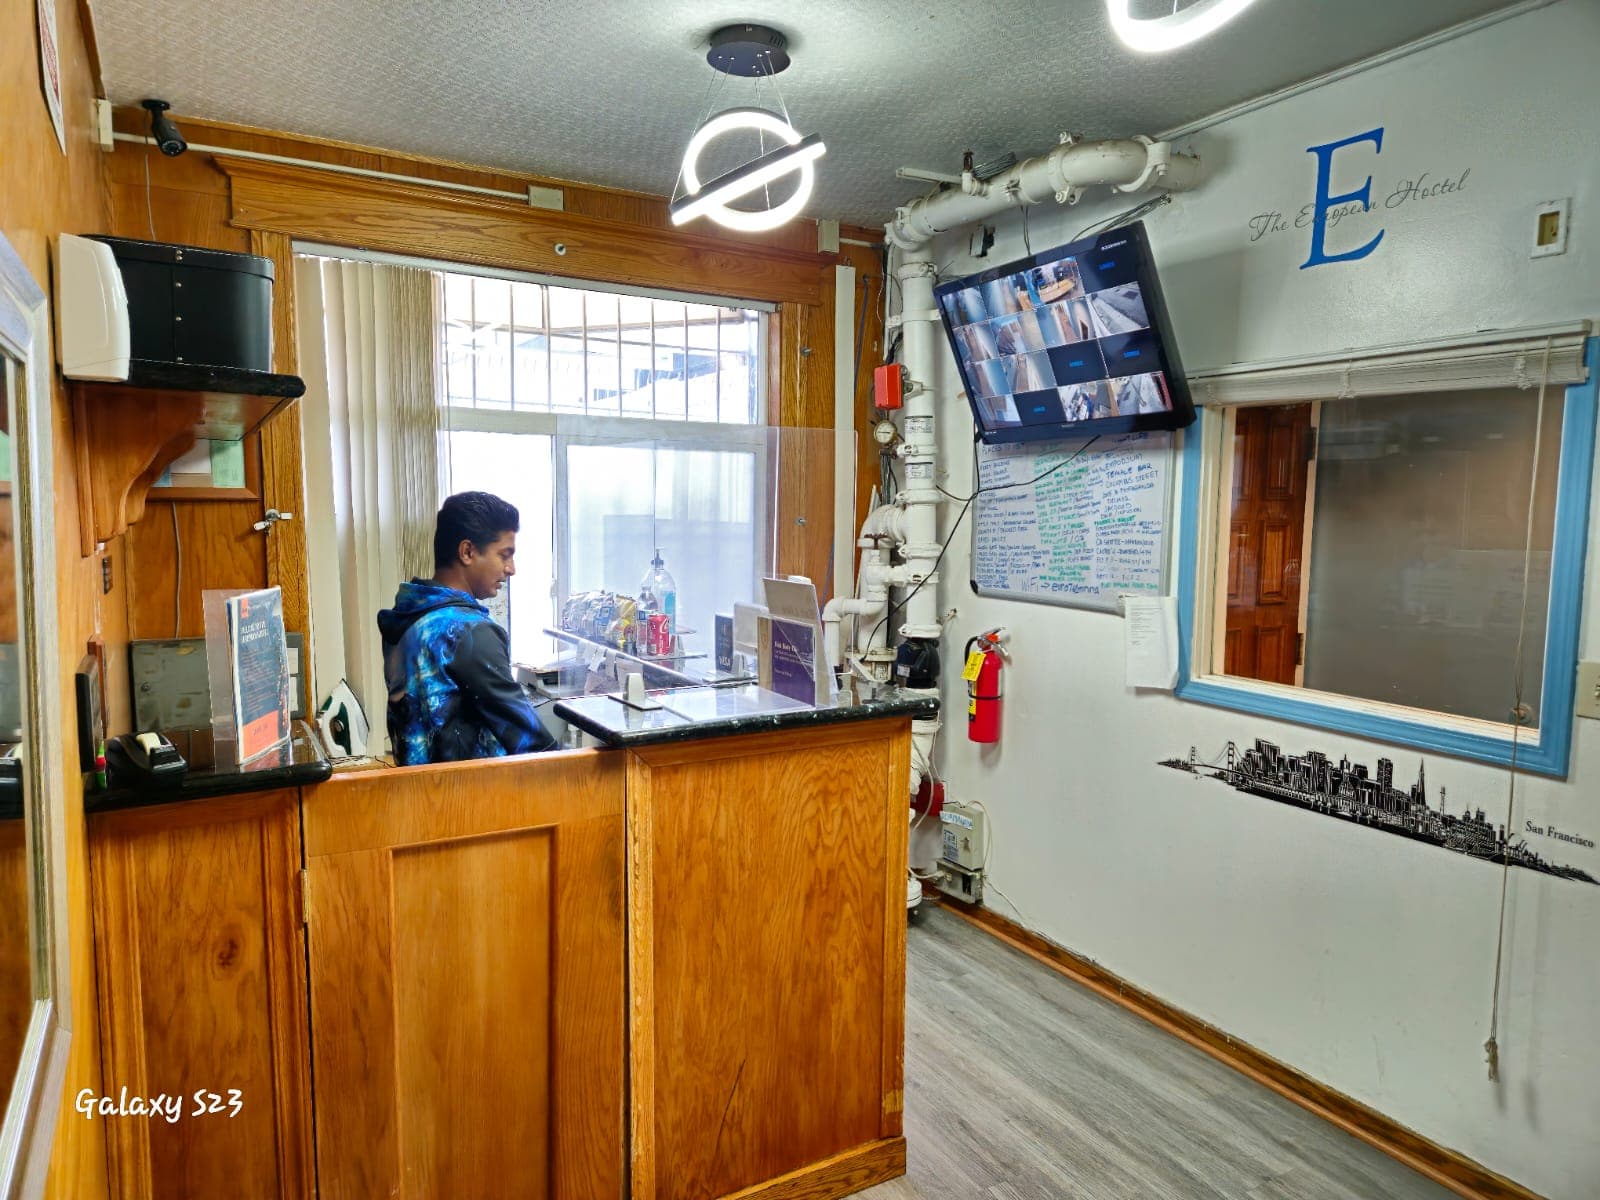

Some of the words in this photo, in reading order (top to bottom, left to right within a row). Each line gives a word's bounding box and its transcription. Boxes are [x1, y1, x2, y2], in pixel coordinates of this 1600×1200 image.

[1248, 211, 1290, 242] The
[1385, 167, 1471, 209] Hostel
[1299, 126, 1385, 271] E
[1525, 820, 1544, 836] San
[1546, 825, 1595, 849] Francisco
